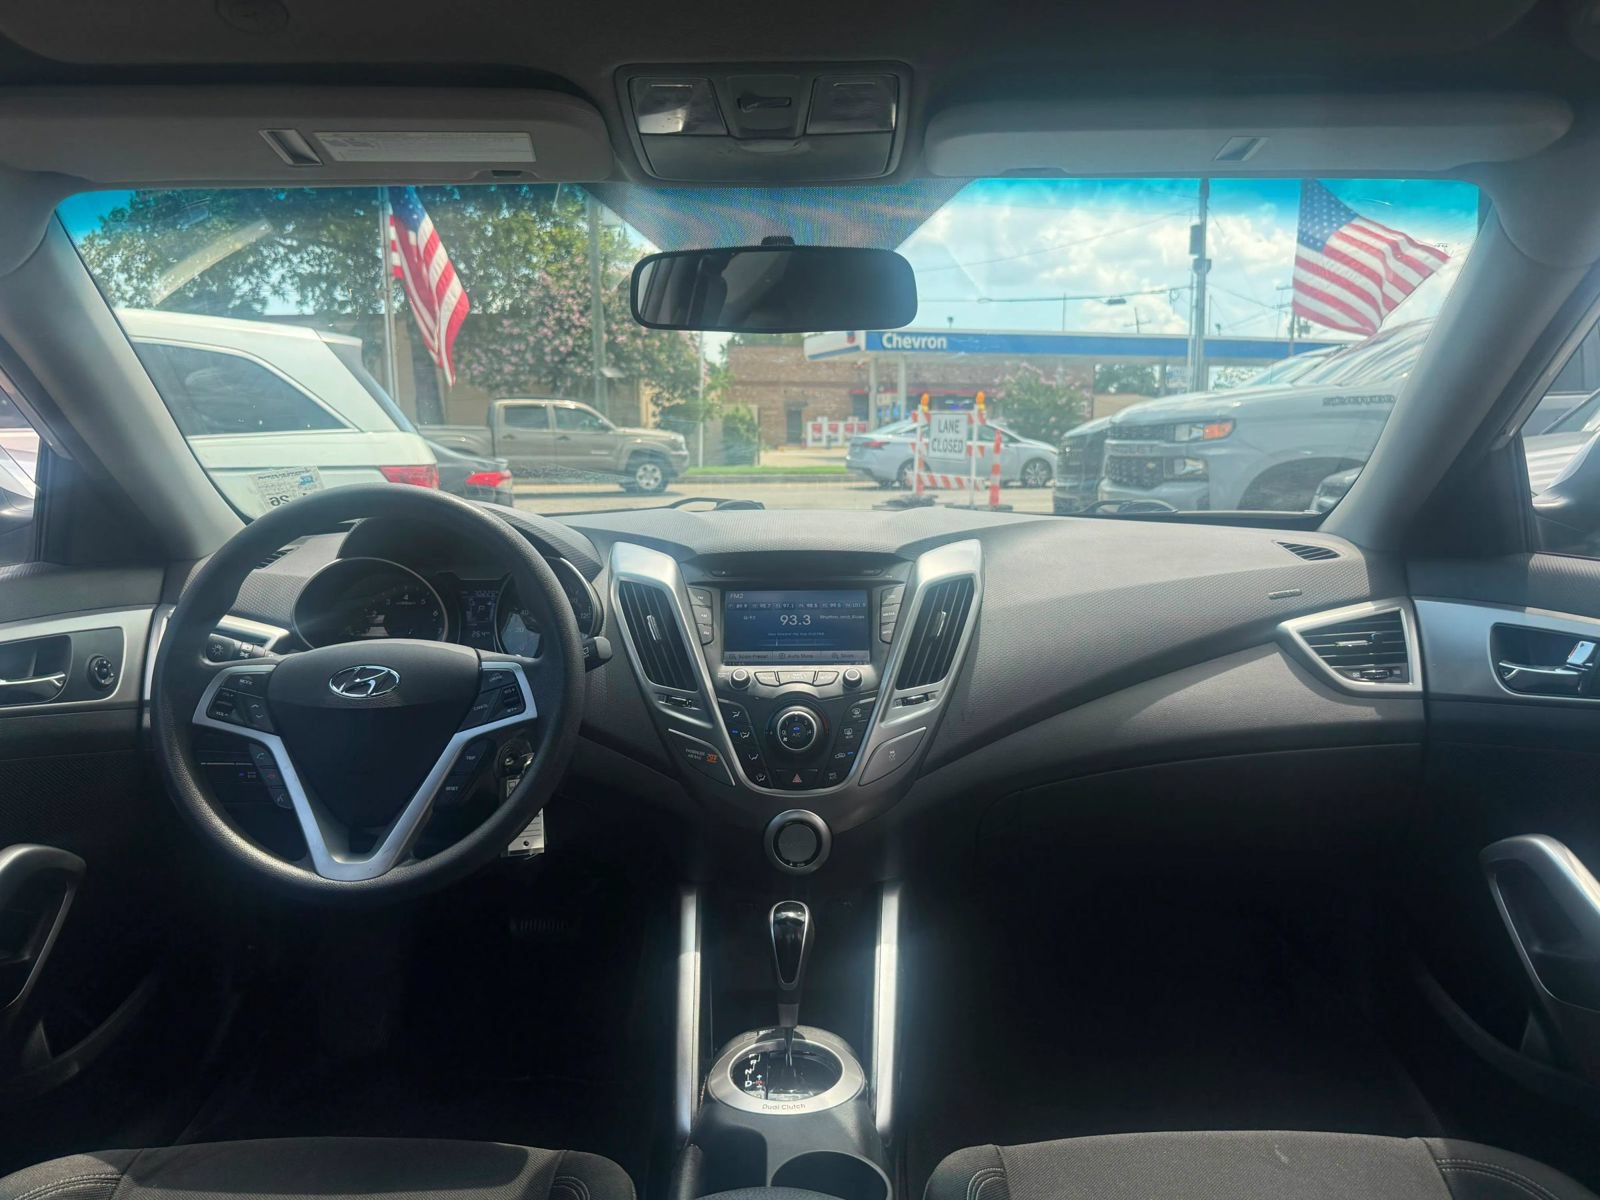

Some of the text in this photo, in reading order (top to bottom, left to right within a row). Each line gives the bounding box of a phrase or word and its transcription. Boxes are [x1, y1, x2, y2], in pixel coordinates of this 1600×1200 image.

[881, 333, 947, 350] Chevron
[937, 418, 960, 434] LANE
[931, 438, 964, 454] CLOSED
[780, 614, 812, 626] 93.3
